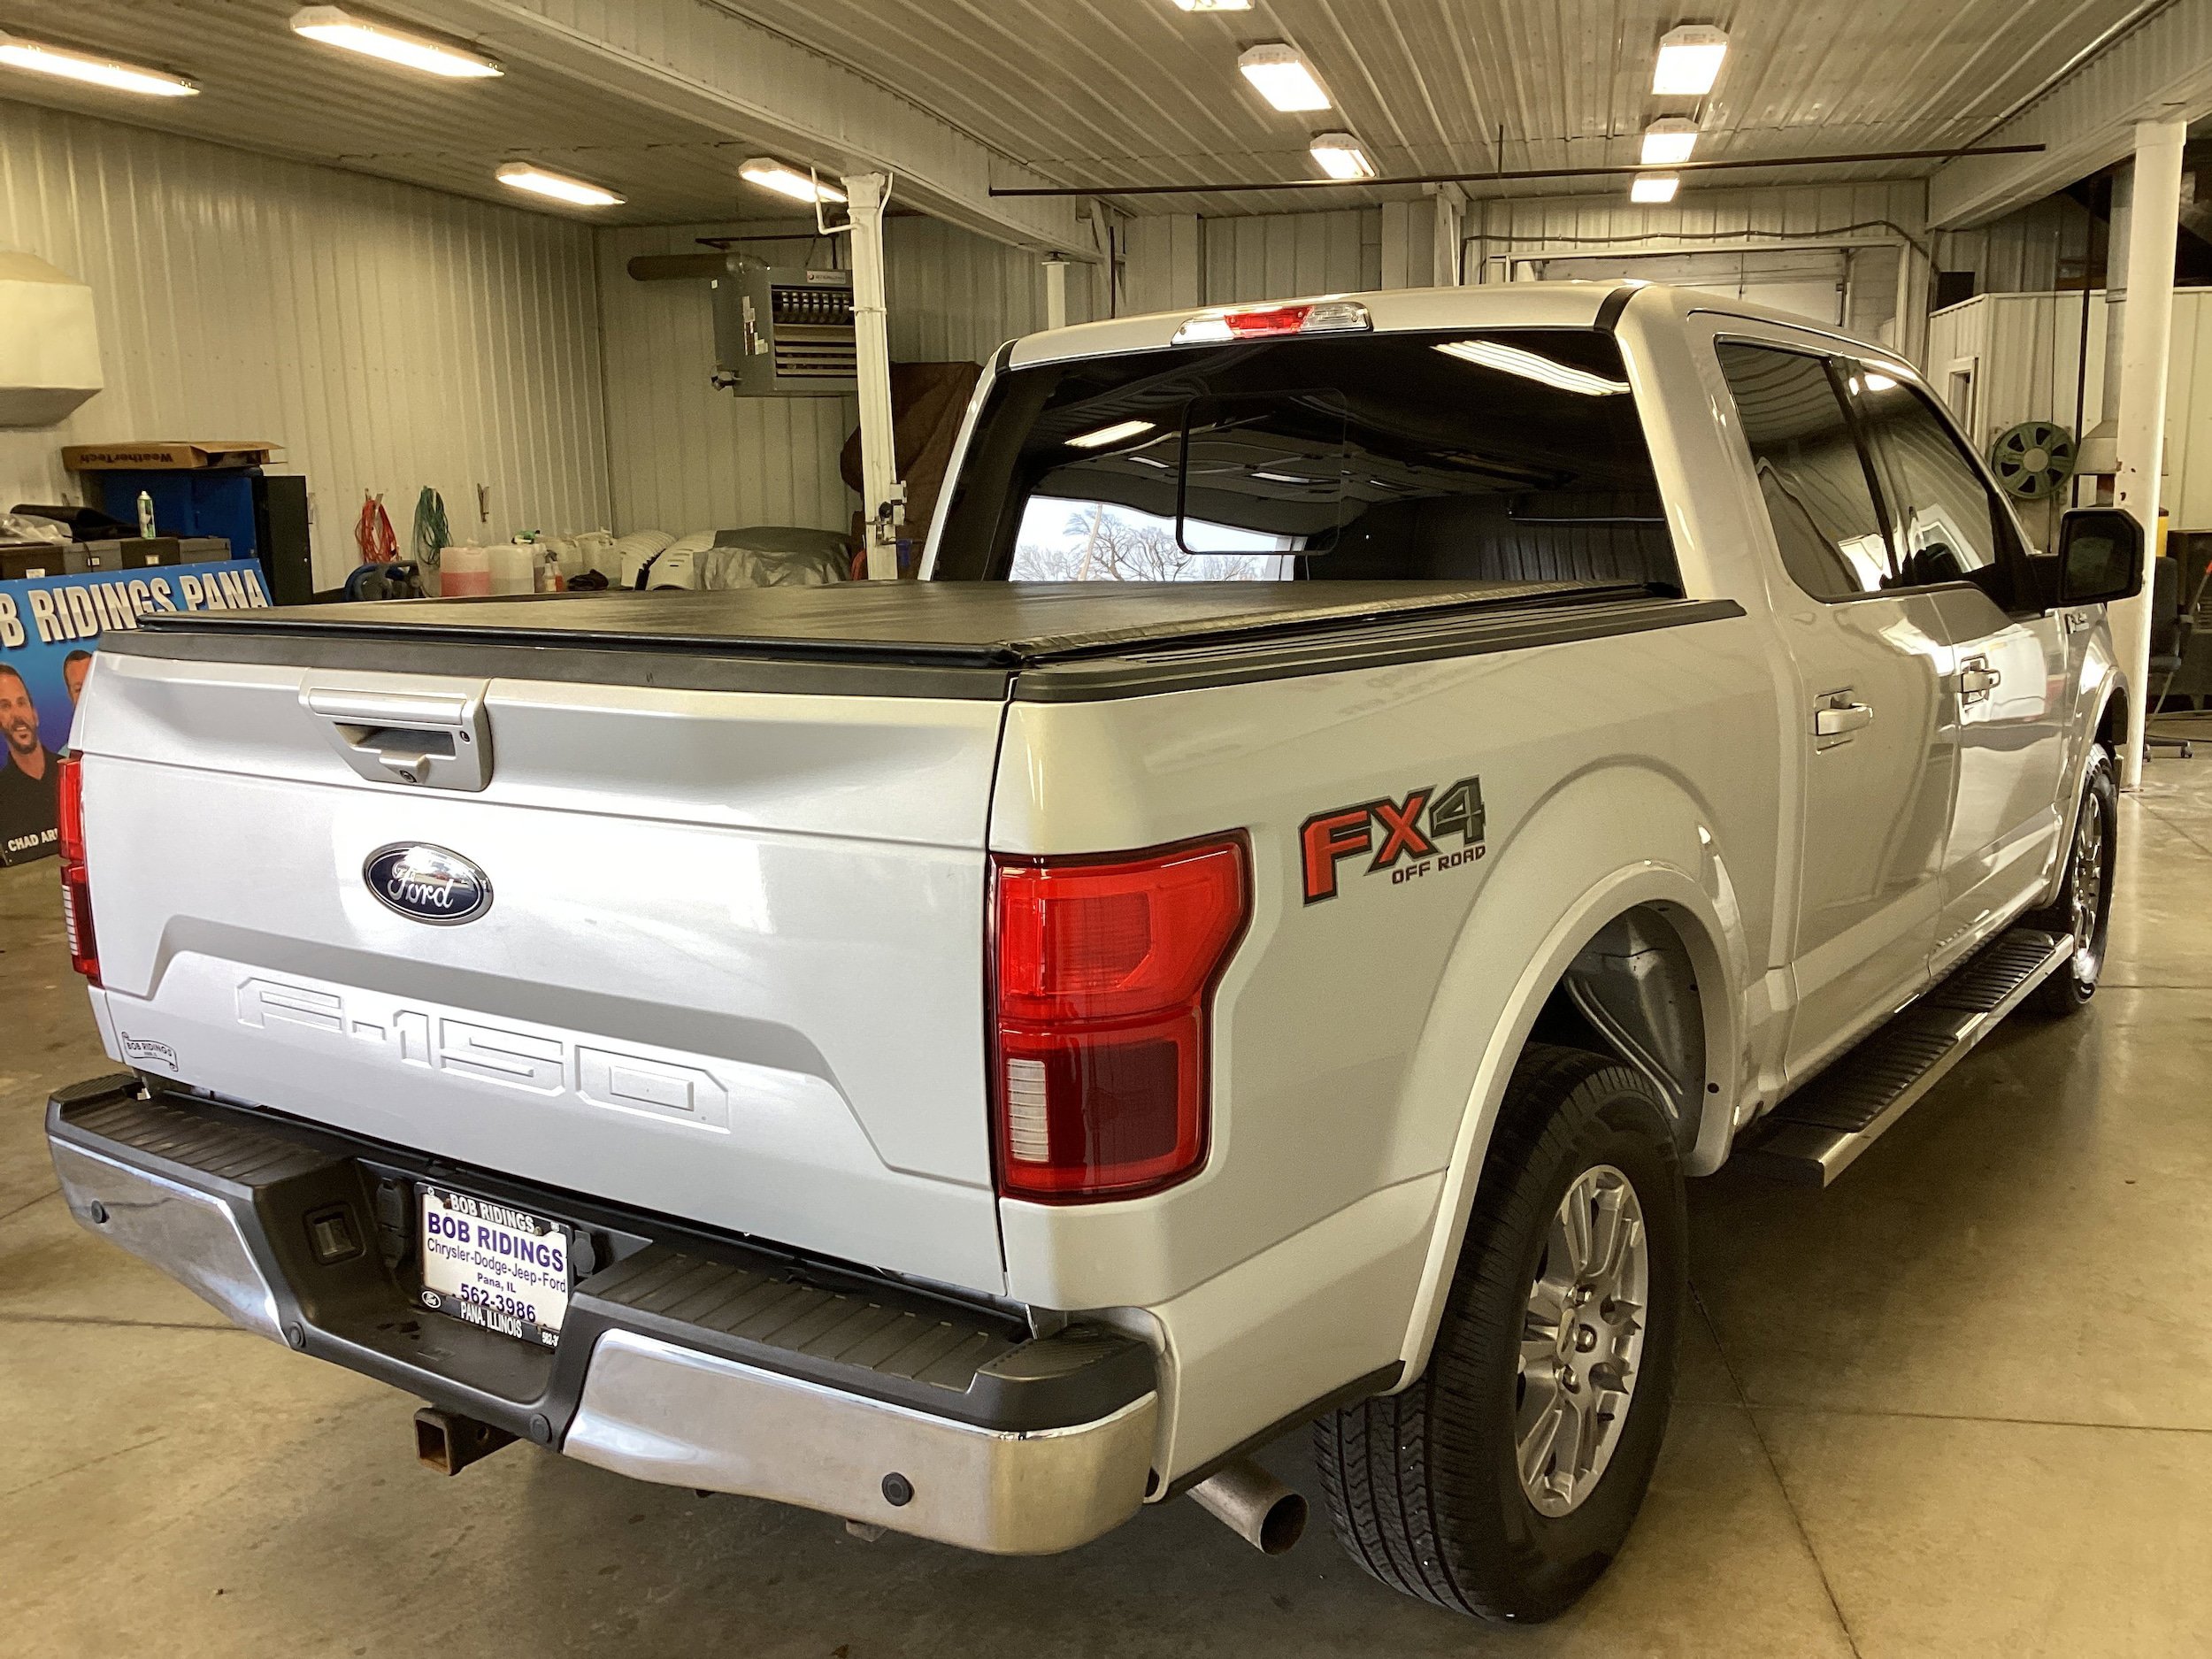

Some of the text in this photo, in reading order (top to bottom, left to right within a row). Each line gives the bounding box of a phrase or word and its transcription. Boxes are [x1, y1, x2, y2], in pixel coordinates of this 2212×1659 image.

[80, 453, 174, 464] WeatherTech
[28, 577, 178, 642] RIDINGS
[179, 569, 268, 611] PANA
[8, 833, 40, 852] CHAD
[1298, 774, 1486, 908] FX4
[387, 861, 455, 909] Ford
[1391, 845, 1486, 886] OFF ROAD
[234, 976, 732, 1136] F-150
[449, 1194, 535, 1233] BOB RIDINGS
[427, 1211, 564, 1272] BOB RIDINGS
[426, 1237, 567, 1294] Chrysler-Dodge-Jeep-Ford
[477, 1271, 517, 1294] Pana, IL
[460, 1282, 537, 1323] 562-3986
[486, 1310, 524, 1339] ILLINOIS
